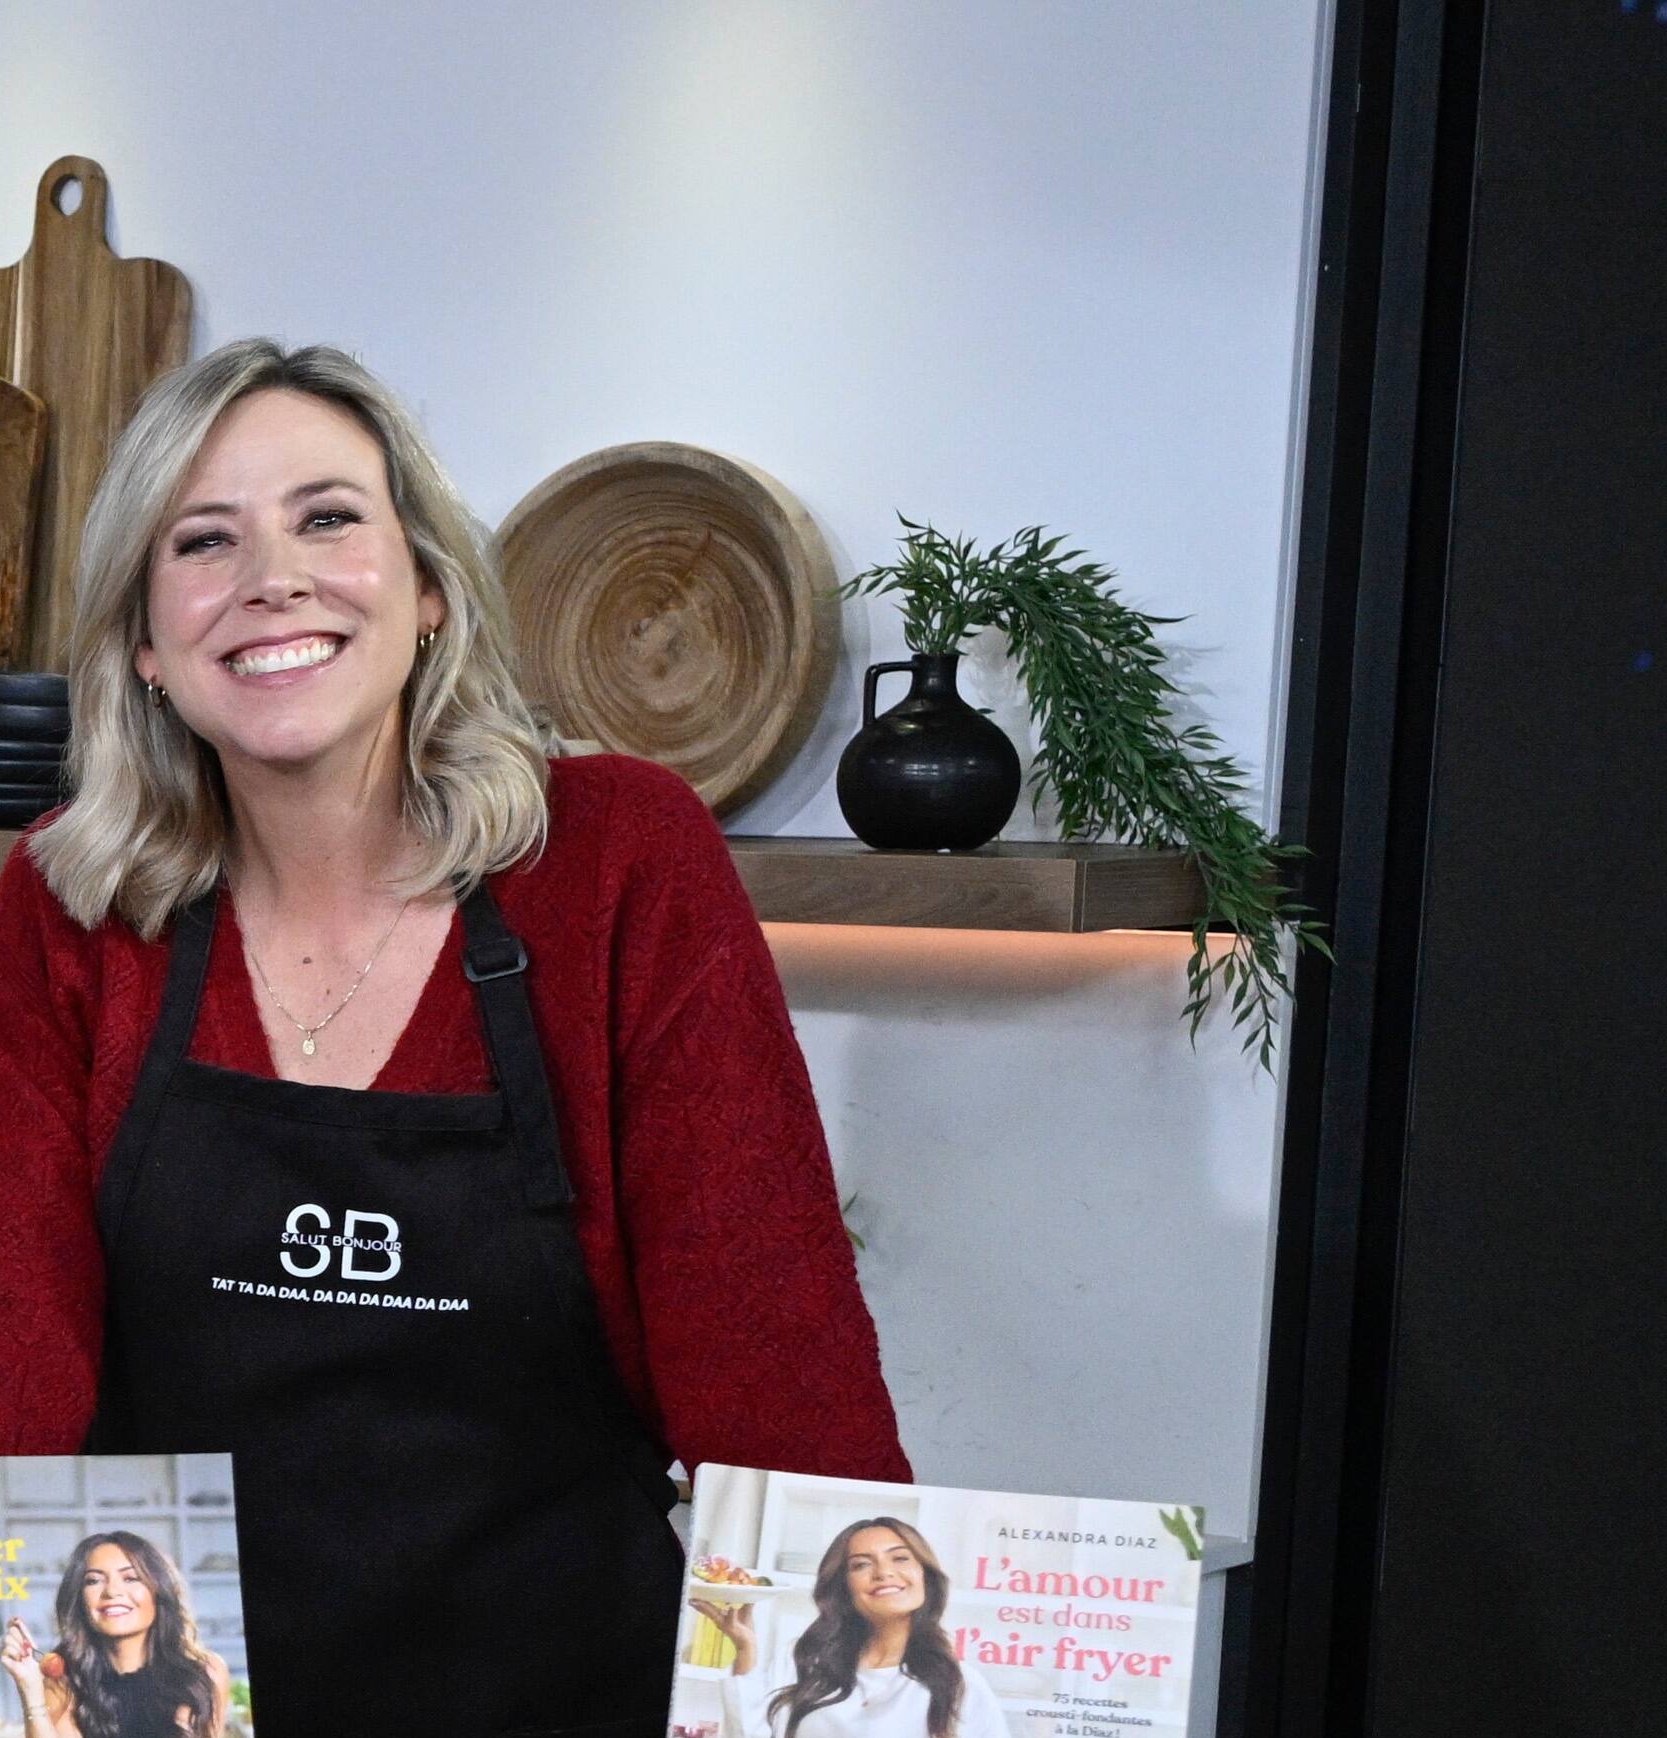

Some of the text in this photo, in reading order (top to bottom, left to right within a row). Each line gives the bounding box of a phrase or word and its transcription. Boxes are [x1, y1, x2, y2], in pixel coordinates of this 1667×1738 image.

[281, 1232, 402, 1252] SALUT BONJOUR
[211, 1277, 469, 1311] TAT TA DA DAA, DA DA DA DAA DA DAA
[998, 1527, 1157, 1549] ALEXANDRA DIAZ
[974, 1556, 1165, 1602] L'amour
[997, 1603, 1133, 1631] est dans
[955, 1627, 1172, 1682] l'air fryer
[1052, 1693, 1128, 1709] 75 recettes
[1026, 1707, 1153, 1727] crousti-fondantes
[1066, 1726, 1078, 1735] la
